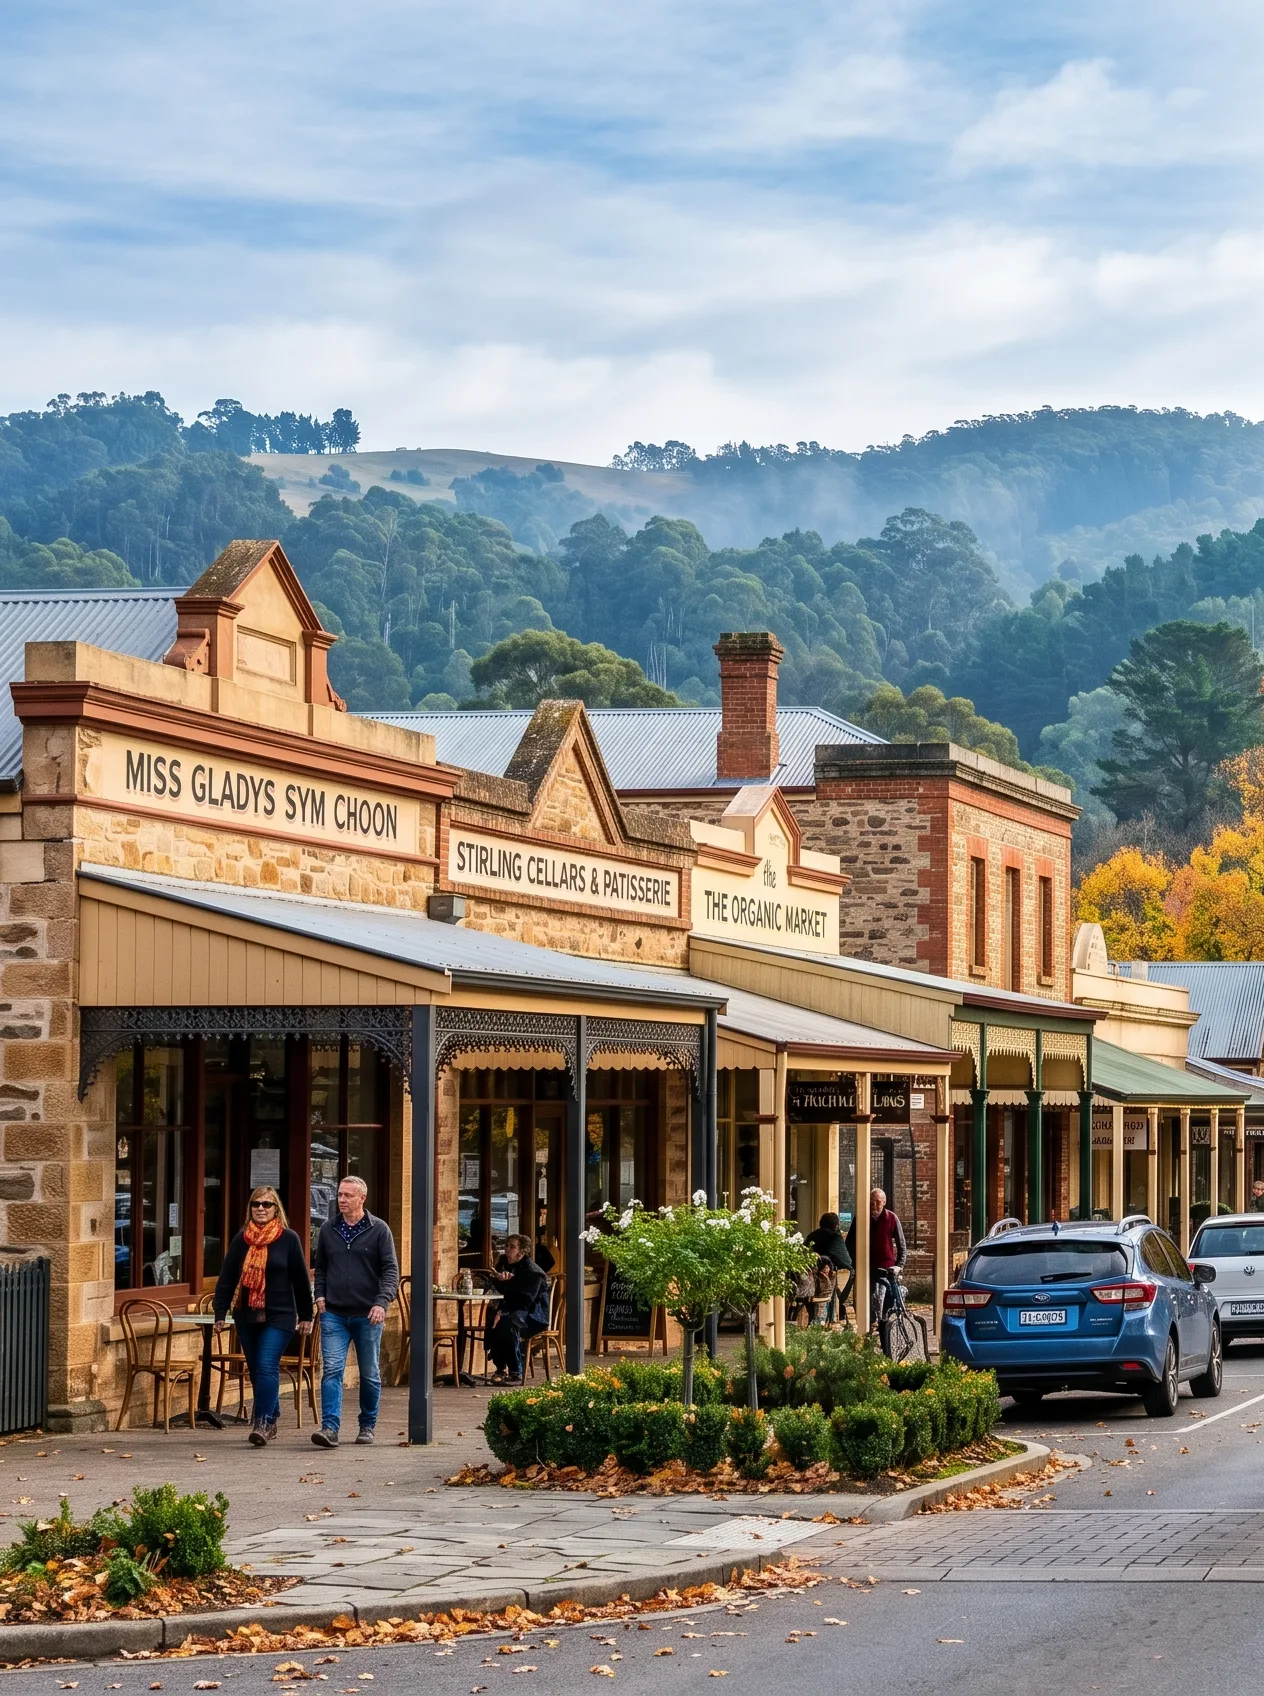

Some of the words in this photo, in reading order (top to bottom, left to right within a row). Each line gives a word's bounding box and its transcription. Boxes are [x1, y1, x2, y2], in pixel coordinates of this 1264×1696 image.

[126, 749, 182, 798] MISS
[191, 764, 276, 816] GLADYS
[285, 784, 325, 826] SYM
[334, 794, 397, 839] CHOON
[457, 840, 522, 881] STIRLING
[527, 855, 586, 892] CELLARS
[590, 867, 599, 895] &
[604, 869, 671, 906] PATISSERIE
[704, 889, 728, 922] THE
[731, 895, 782, 932] ORGANIC
[785, 905, 827, 938] MARKET
